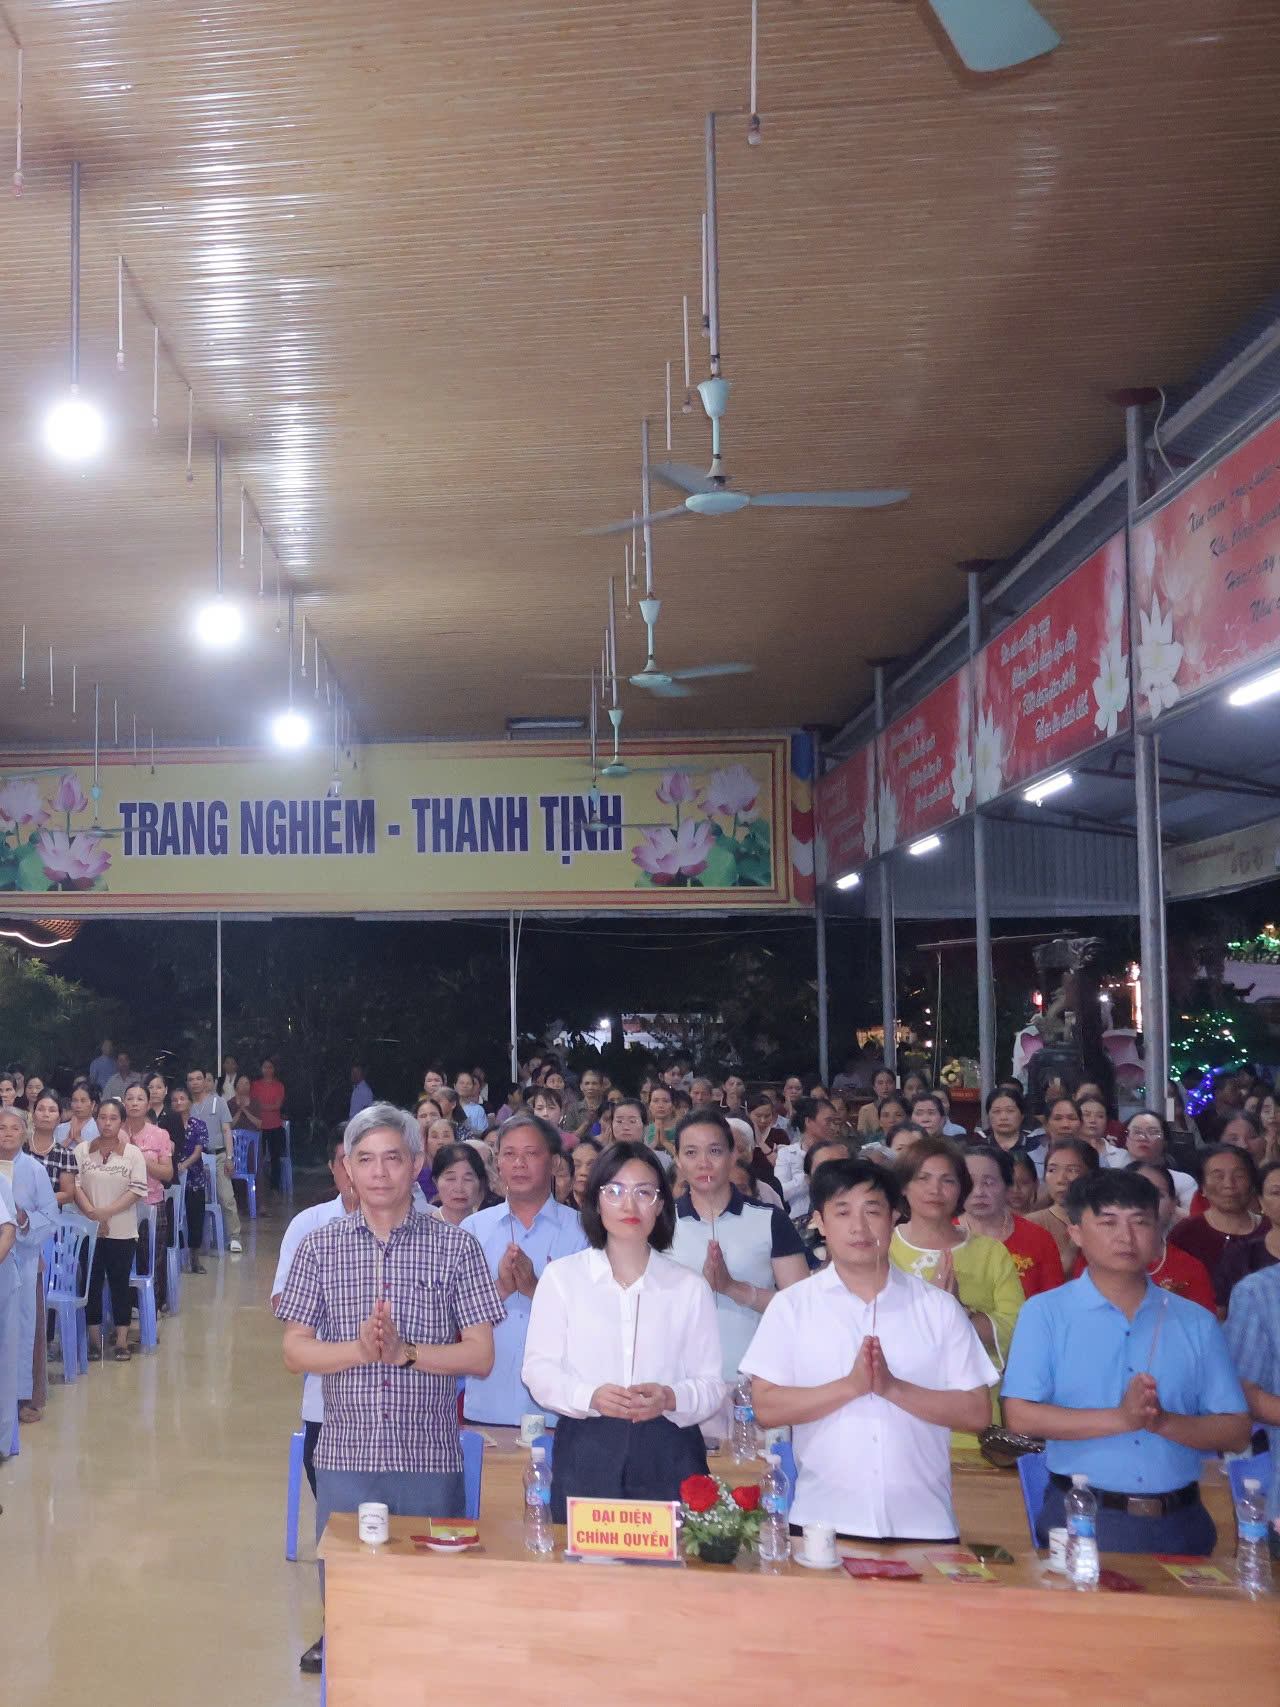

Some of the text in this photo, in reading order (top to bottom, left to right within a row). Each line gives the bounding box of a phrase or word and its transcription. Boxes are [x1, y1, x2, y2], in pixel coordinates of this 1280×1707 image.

[120, 800, 228, 856] TRANG
[411, 796, 529, 853] THANH
[540, 794, 622, 865] TỊNH
[592, 1508, 652, 1527] ĐẠI DIỆN
[576, 1528, 669, 1548] CHÍNH QUYỀN
